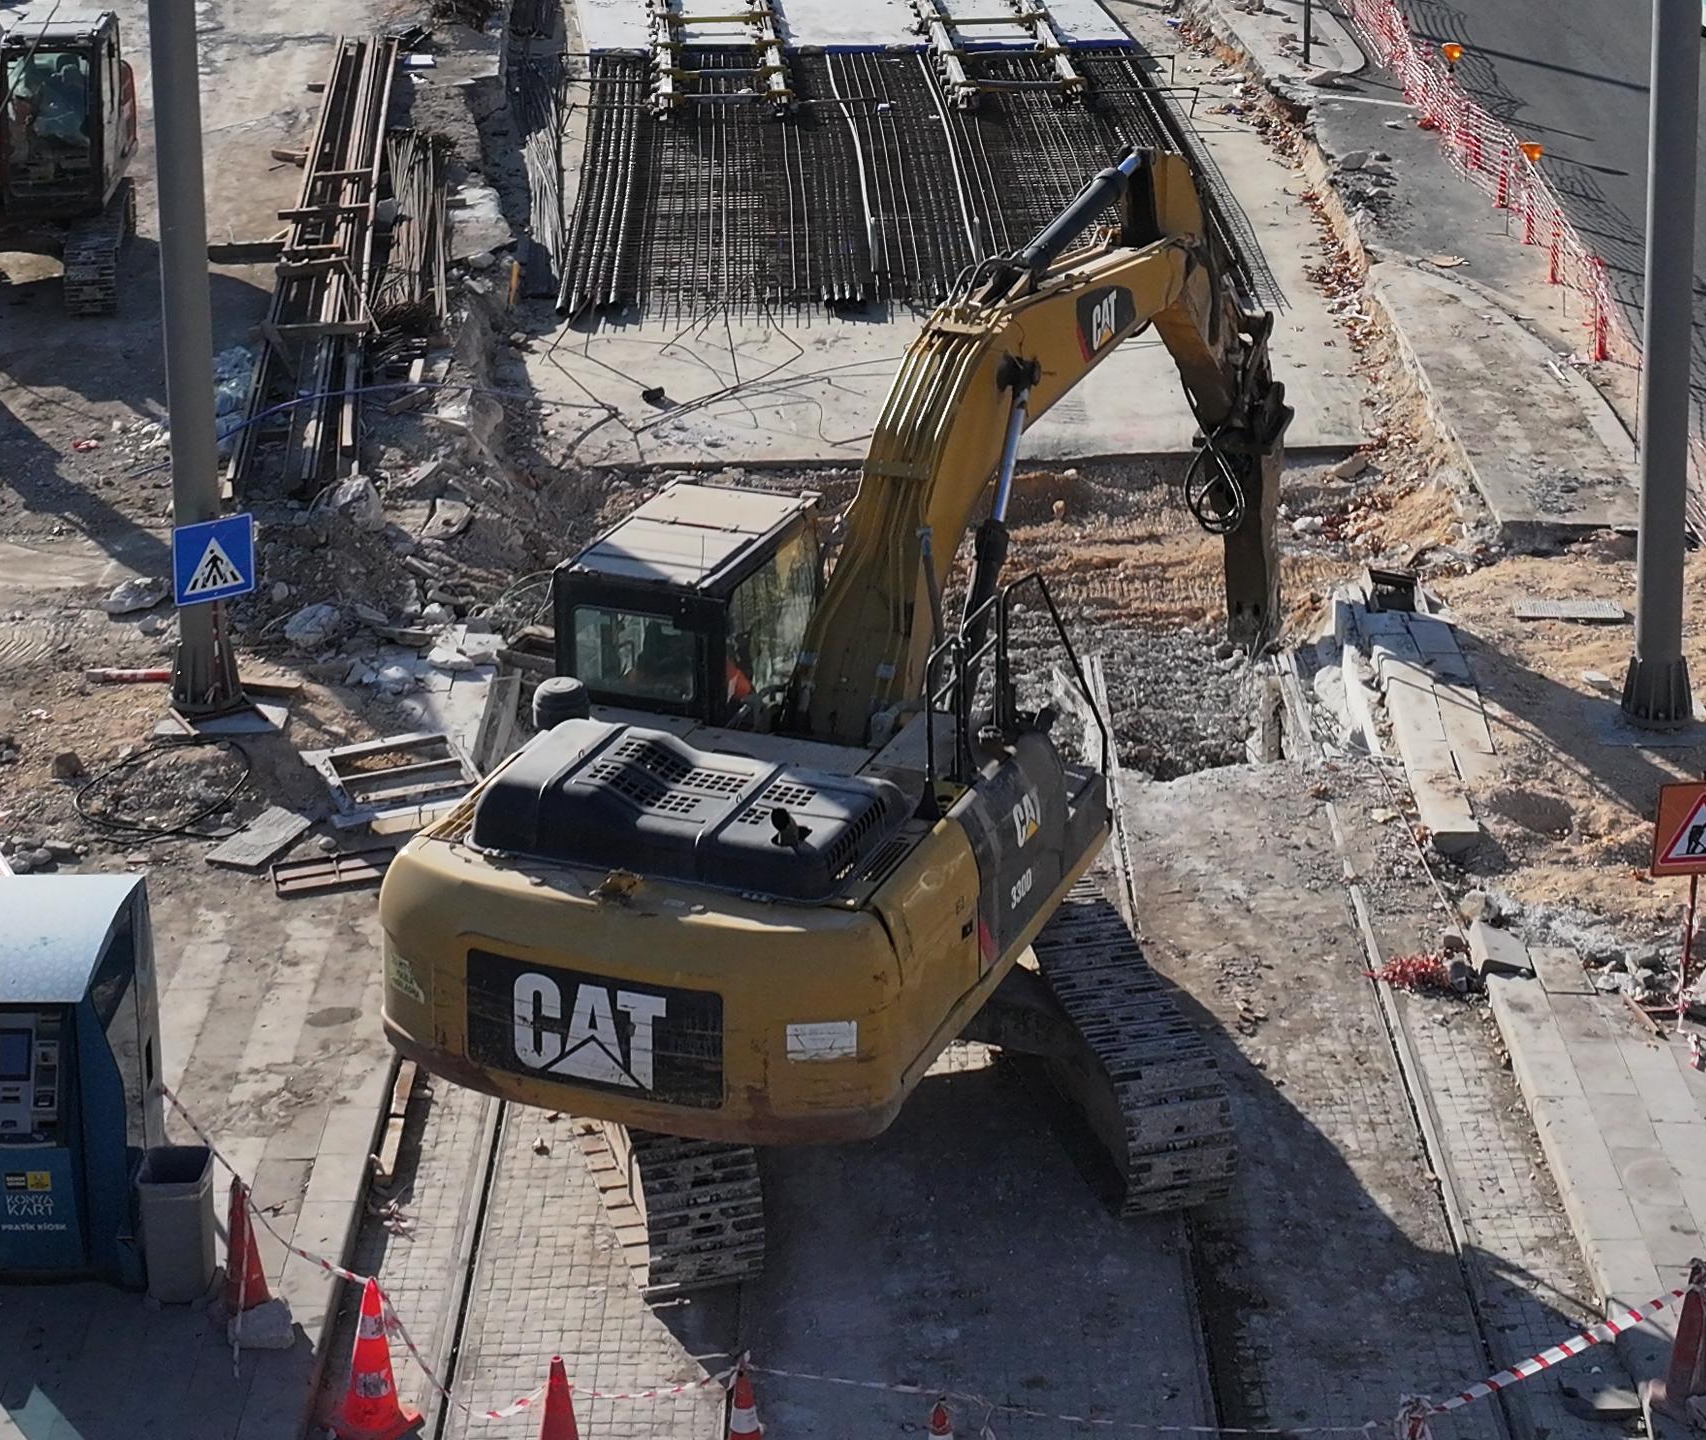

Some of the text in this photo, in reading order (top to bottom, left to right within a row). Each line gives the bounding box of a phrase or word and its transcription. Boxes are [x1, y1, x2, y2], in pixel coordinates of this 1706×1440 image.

[1092, 289, 1117, 351] CAT
[1012, 786, 1042, 848] CAT
[1010, 868, 1033, 910] 330D
[514, 972, 667, 1091] CAT
[5, 1195, 53, 1205] KONYA
[7, 1204, 54, 1216] KART
